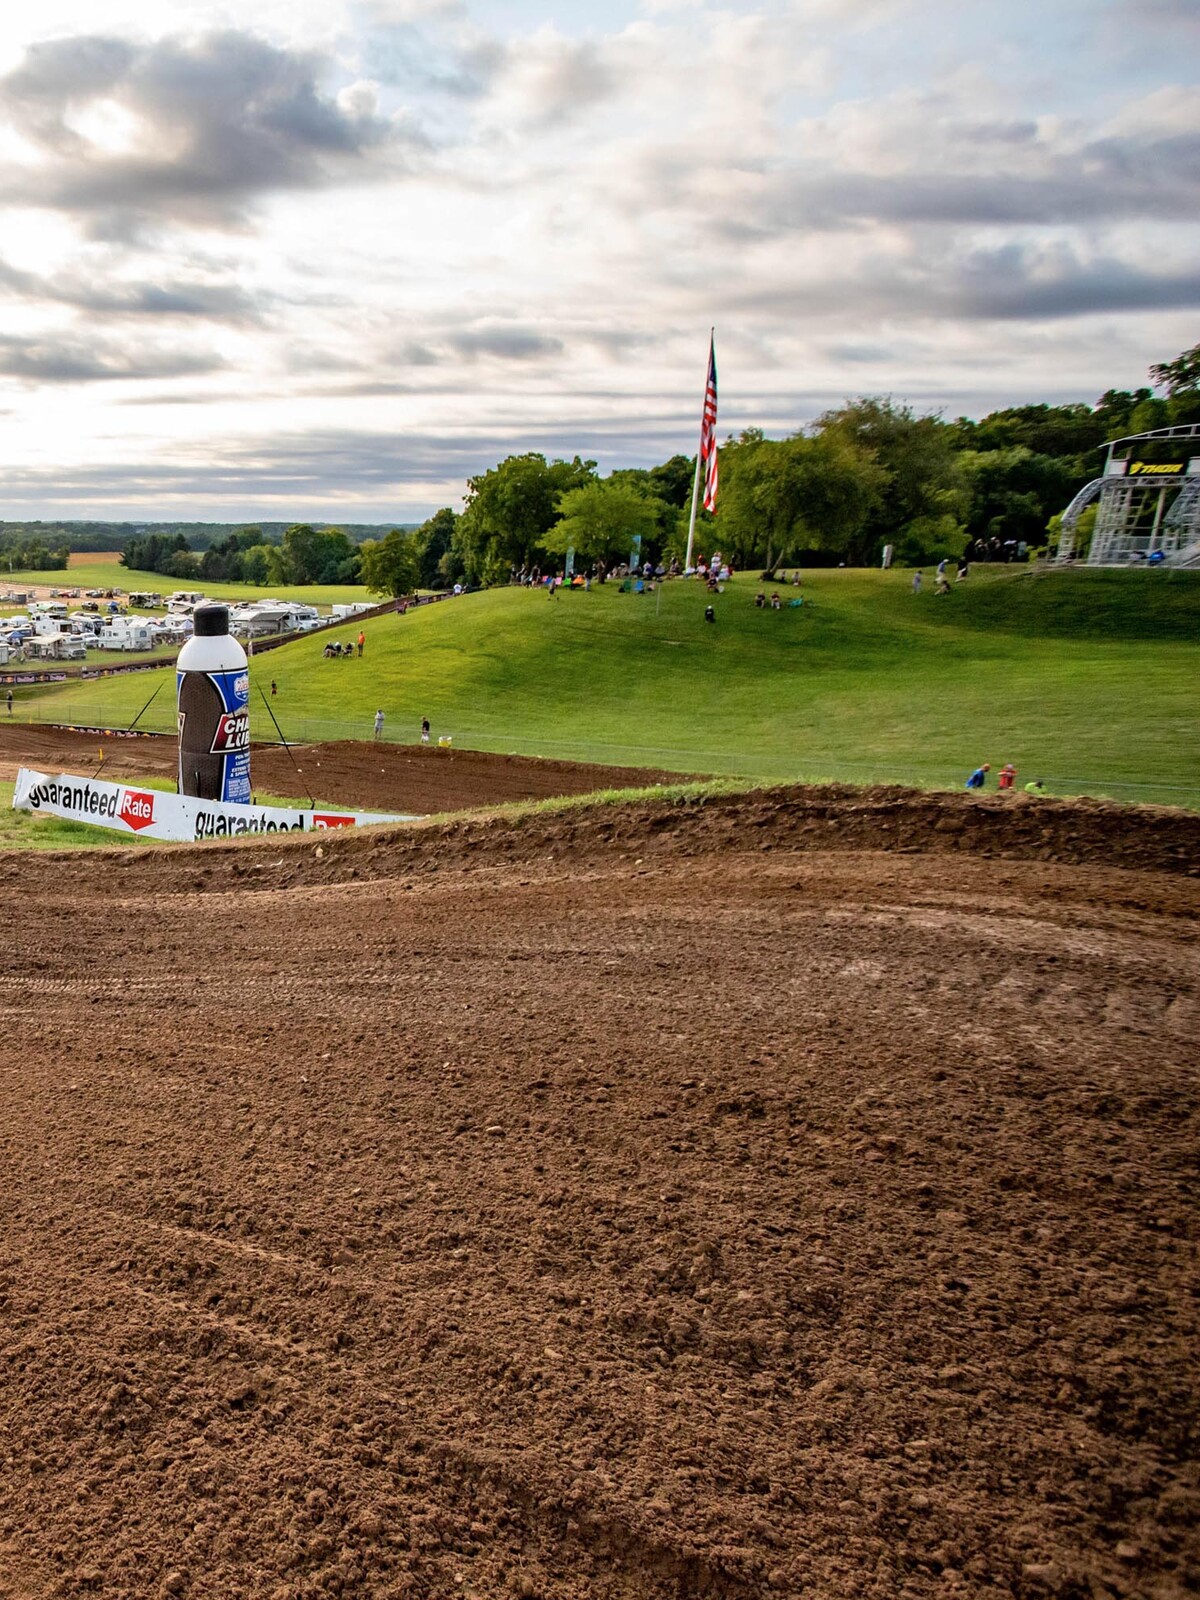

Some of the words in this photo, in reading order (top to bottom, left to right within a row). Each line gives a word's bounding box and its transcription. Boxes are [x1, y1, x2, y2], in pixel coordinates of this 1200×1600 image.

[1140, 464, 1184, 473] THOR
[28, 783, 120, 819] guaranteed
[123, 798, 152, 818] Rate
